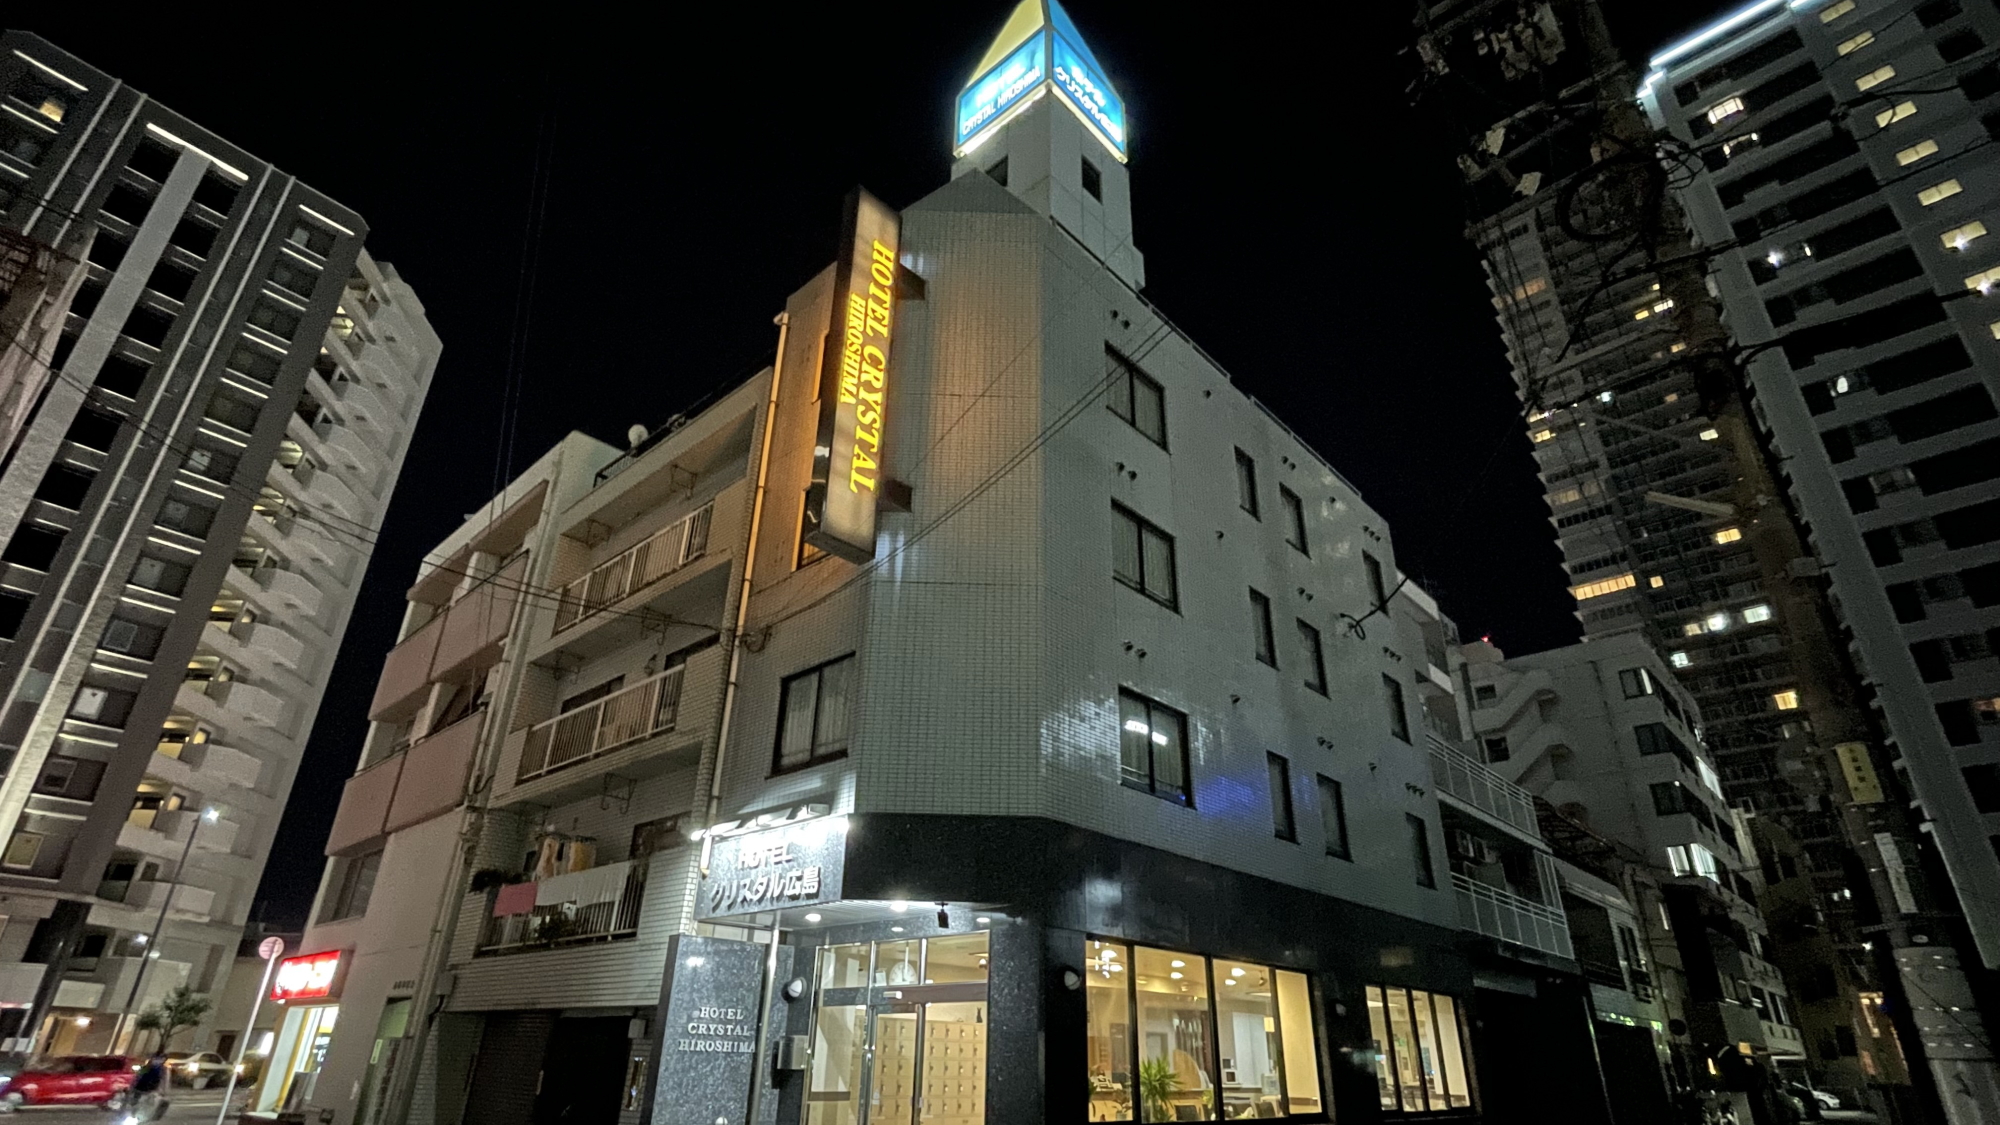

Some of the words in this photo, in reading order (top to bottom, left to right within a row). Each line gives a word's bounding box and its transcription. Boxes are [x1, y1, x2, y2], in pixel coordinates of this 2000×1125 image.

[865, 239, 895, 338] HOTEL
[840, 292, 867, 405] HIROSHIMA
[849, 343, 886, 494] CRYSTAL
[737, 843, 794, 870] HOTEL
[710, 865, 821, 910] クリスタル広島
[687, 1022, 750, 1037] CRYSTAL
[699, 1006, 744, 1020] HOTEL
[678, 1039, 755, 1053] HIROSHIMA
